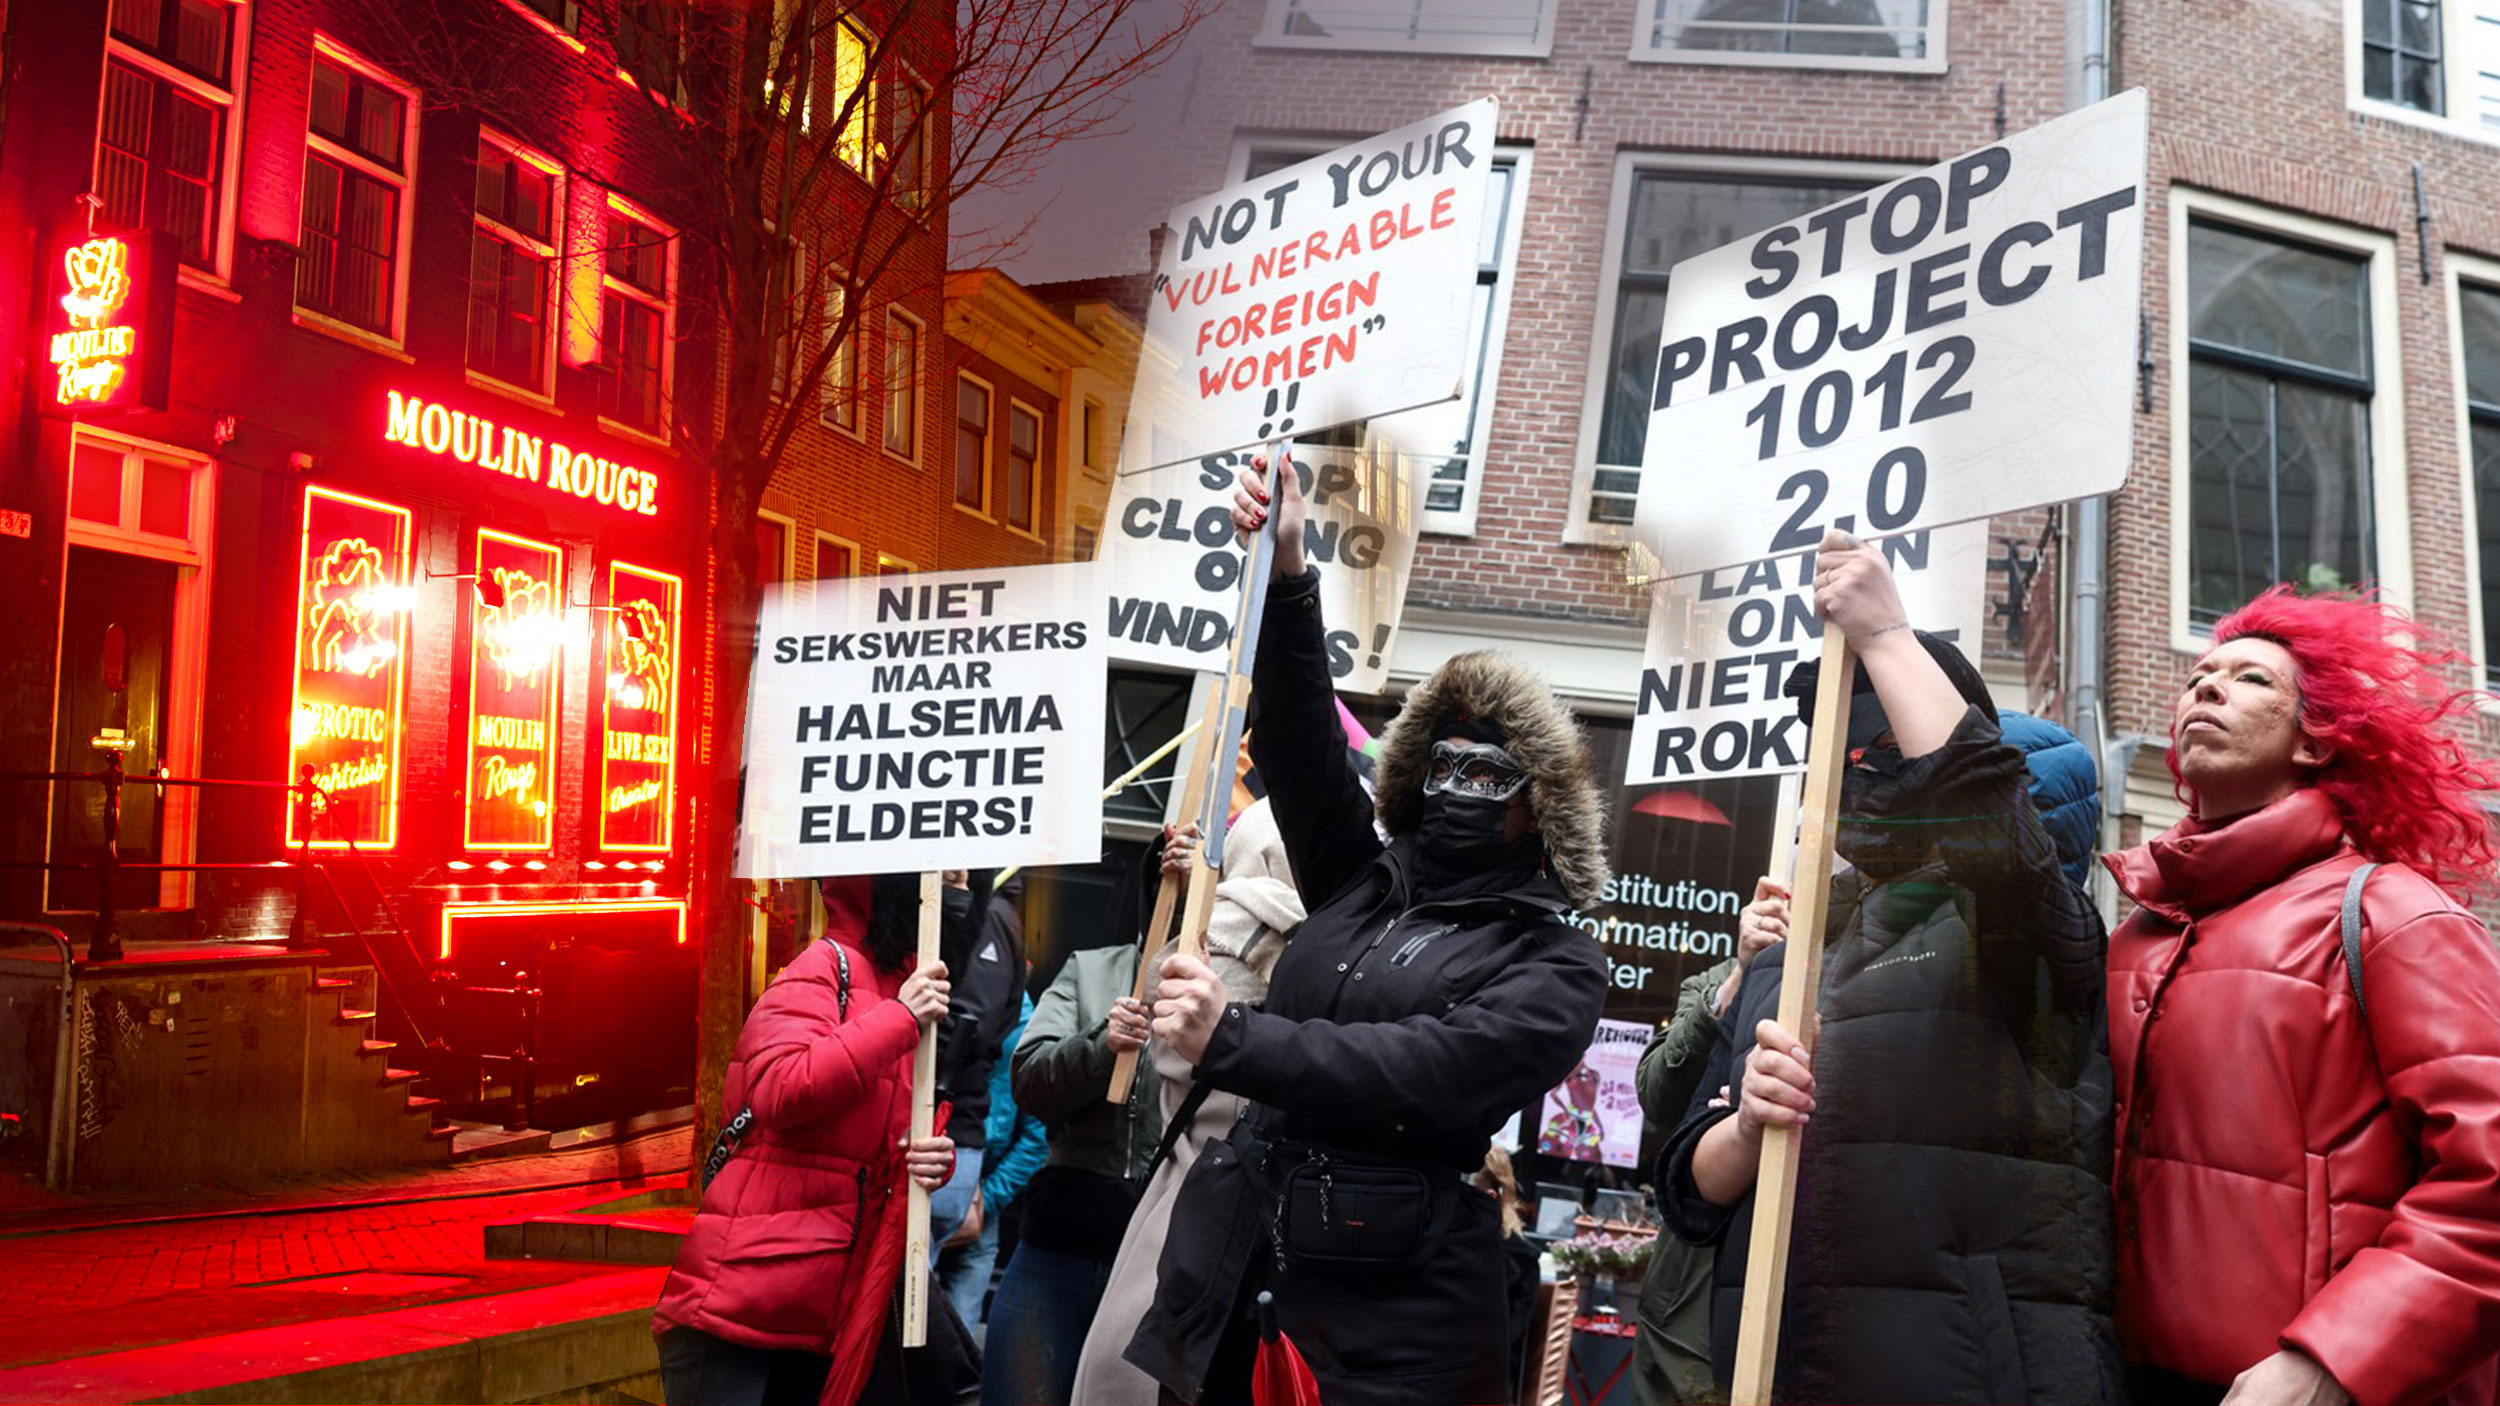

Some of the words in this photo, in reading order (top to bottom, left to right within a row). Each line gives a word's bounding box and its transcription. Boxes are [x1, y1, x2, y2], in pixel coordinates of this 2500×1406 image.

[1181, 179, 1299, 261] NOT
[1327, 121, 1475, 208] YOUR
[1745, 146, 2011, 300] STOP
[1196, 271, 1381, 356] FOREIGN
[1653, 185, 2136, 412] PROJECT
[1746, 335, 1976, 461] 1012
[385, 390, 543, 482] MOULIN
[547, 443, 658, 516] ROUGE
[1199, 451, 1355, 505] SOP
[1768, 446, 1926, 553] 2.0
[1121, 497, 1386, 570] CLONG
[1698, 530, 1931, 601] LAN
[877, 580, 1005, 623] NIET
[773, 621, 1088, 664] SEKSWERKERS
[872, 660, 992, 693] MAAR
[1637, 649, 1799, 716] NIET
[310, 702, 385, 743] EROTIC
[477, 714, 545, 751] MOULIN
[796, 694, 1063, 743] HALSEMA
[607, 730, 642, 761] LIVE
[643, 734, 670, 763] SEX
[800, 746, 1045, 793] FUNCTIE
[484, 755, 537, 804] Rouge
[799, 796, 1034, 844] ELDERS!
